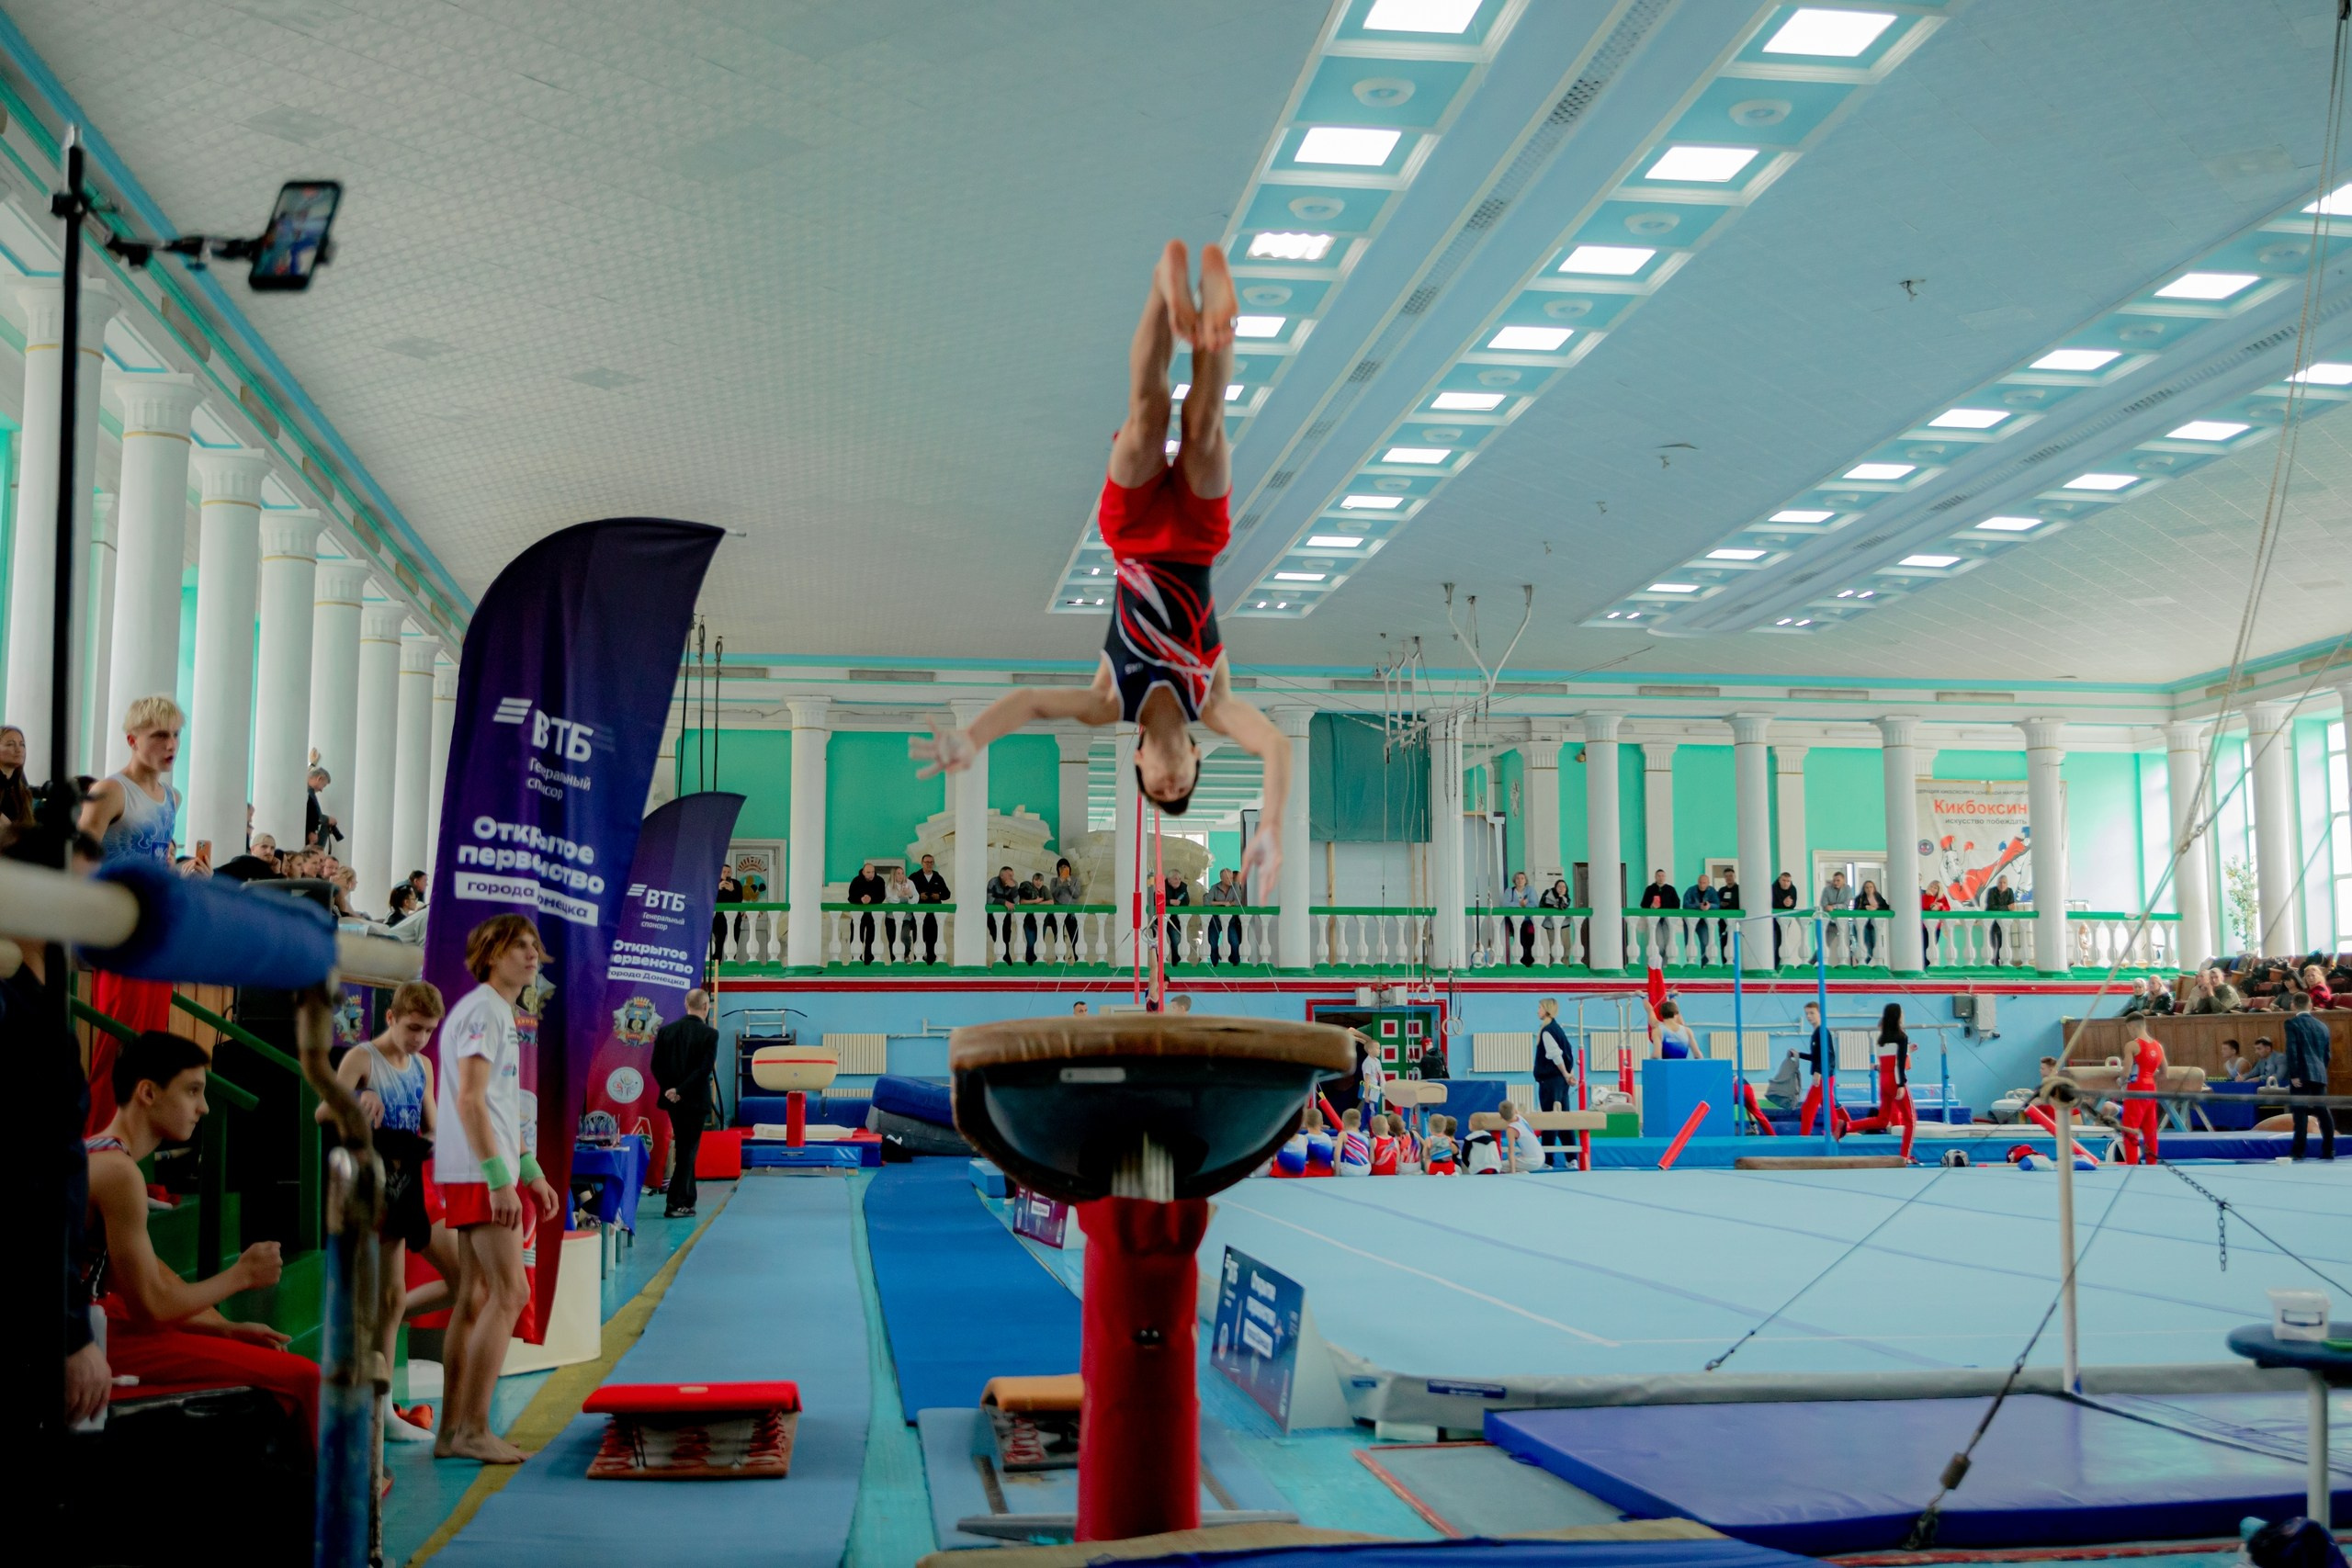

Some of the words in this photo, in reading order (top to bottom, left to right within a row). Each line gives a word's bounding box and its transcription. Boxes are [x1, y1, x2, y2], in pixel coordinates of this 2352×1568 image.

[532, 709, 594, 762] ВТБ
[1933, 799, 2028, 815] Кикбоксин
[467, 880, 536, 898] города
[645, 889, 686, 912] ВТБ
[640, 920, 668, 931] спонсор
[642, 912, 685, 925] Генеральный
[613, 940, 688, 961] Открытое
[642, 973, 685, 987] Донецка
